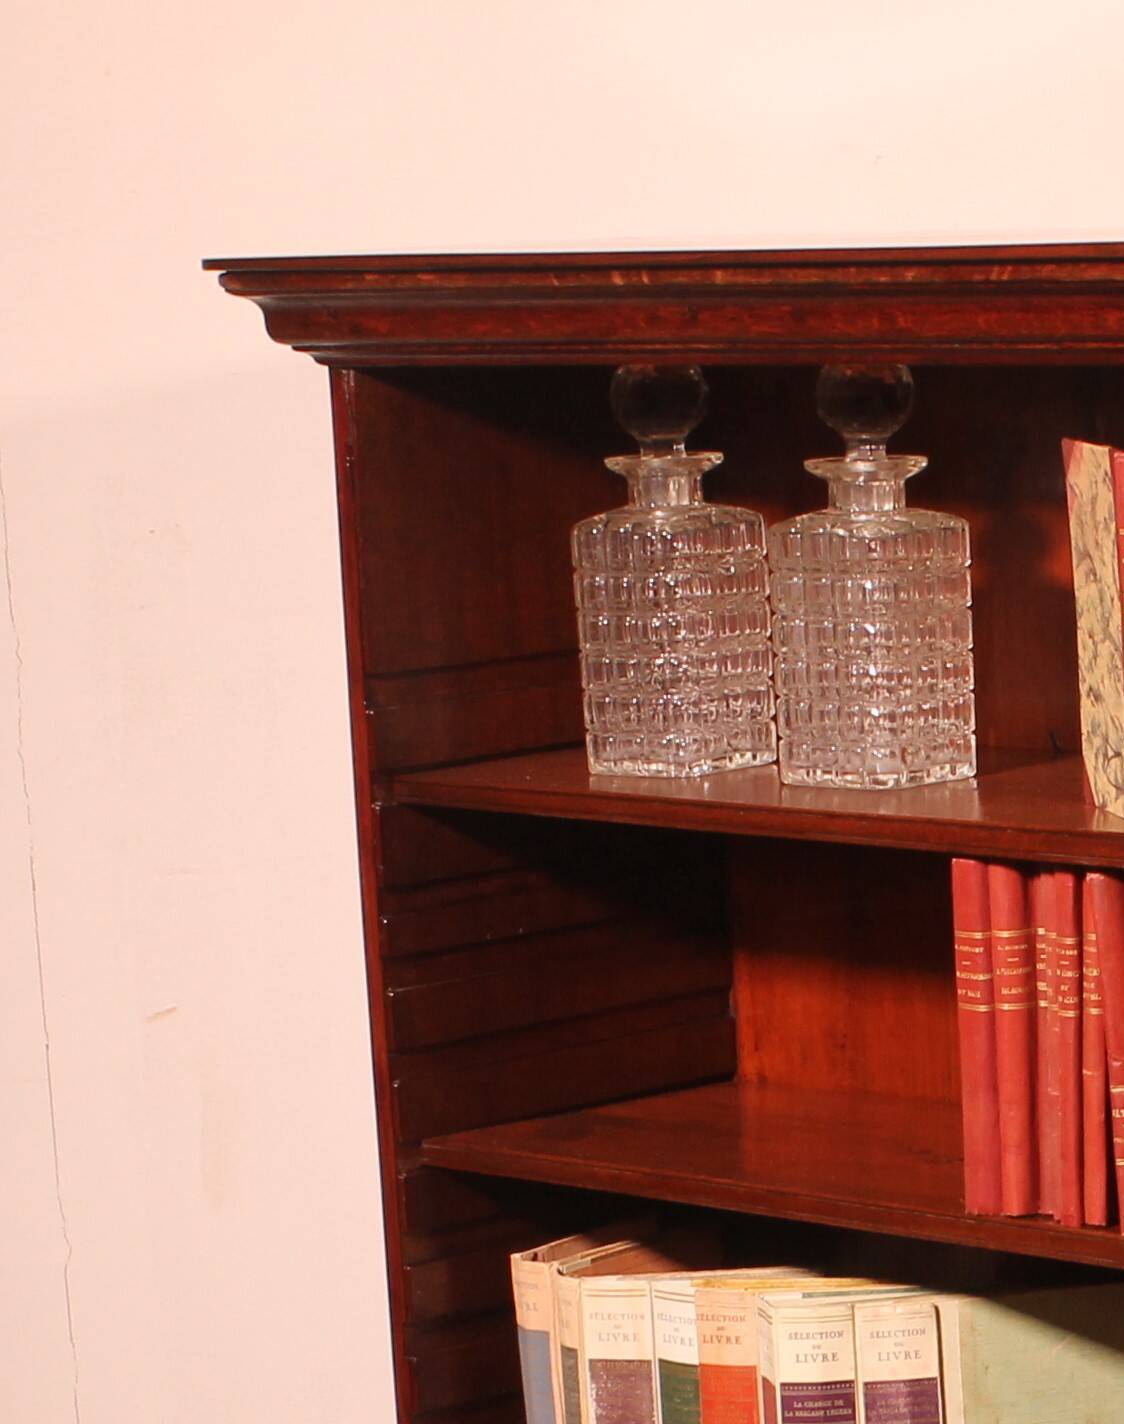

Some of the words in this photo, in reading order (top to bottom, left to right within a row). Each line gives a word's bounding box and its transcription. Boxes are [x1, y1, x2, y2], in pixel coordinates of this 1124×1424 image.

[597, 1331, 640, 1343] LIVRE
[662, 1333, 695, 1347] LIVRE
[702, 1333, 743, 1345] LIVRE
[795, 1351, 840, 1364] LIVRE
[877, 1349, 922, 1362] LIVRE
